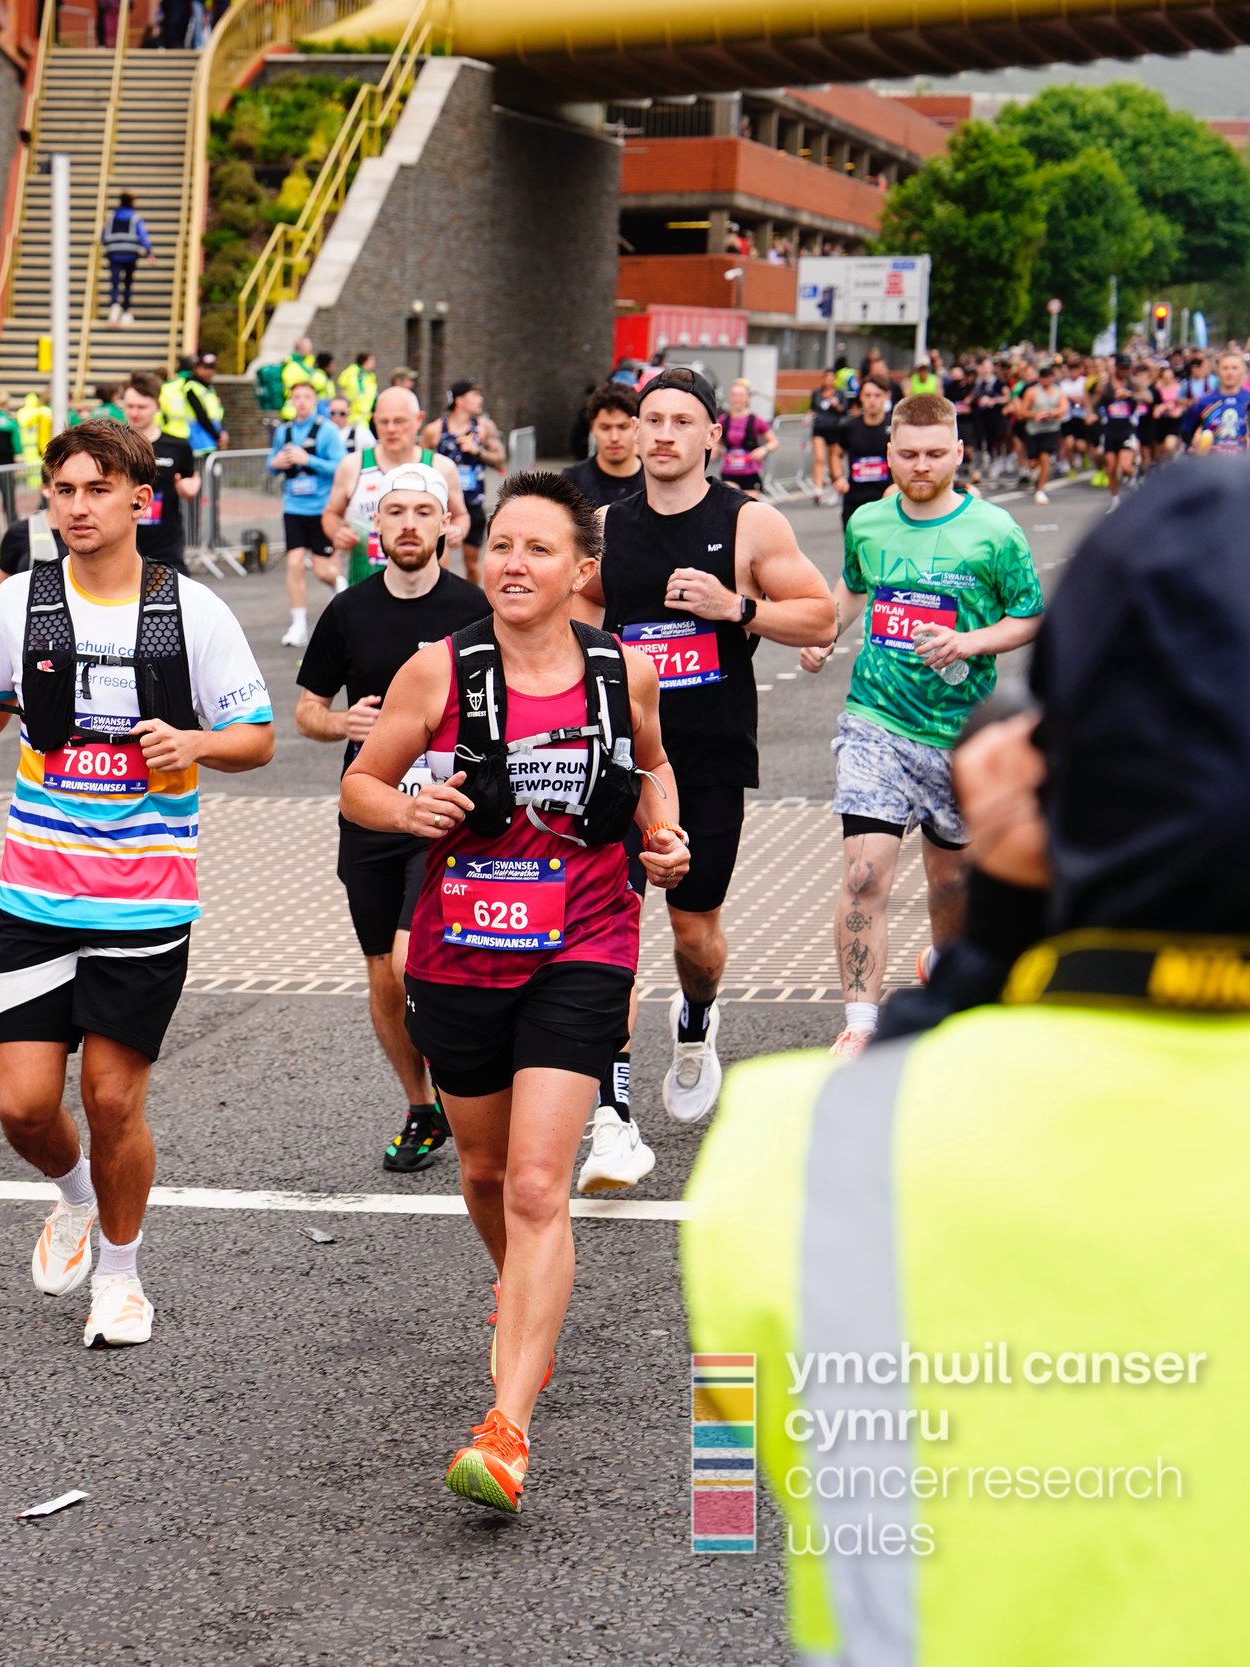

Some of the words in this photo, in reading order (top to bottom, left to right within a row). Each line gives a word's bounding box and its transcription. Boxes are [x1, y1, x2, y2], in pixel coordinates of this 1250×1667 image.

[708, 543, 723, 552] MP
[874, 603, 904, 616] DYLAN
[662, 621, 696, 630] SWANSEA
[76, 641, 115, 655] chwil
[631, 643, 668, 653] NDREW
[649, 650, 700, 675] 712
[659, 676, 702, 688] NSWANSEA
[93, 716, 132, 726] SWANSEA
[63, 749, 128, 776] 7803
[508, 761, 552, 775] ERRY
[61, 780, 126, 792] #RUNSWANSEA
[495, 861, 539, 870] SWANSEA
[443, 883, 468, 896] CAT
[473, 900, 528, 930] 628
[465, 934, 539, 948] #RUNSWANSEA
